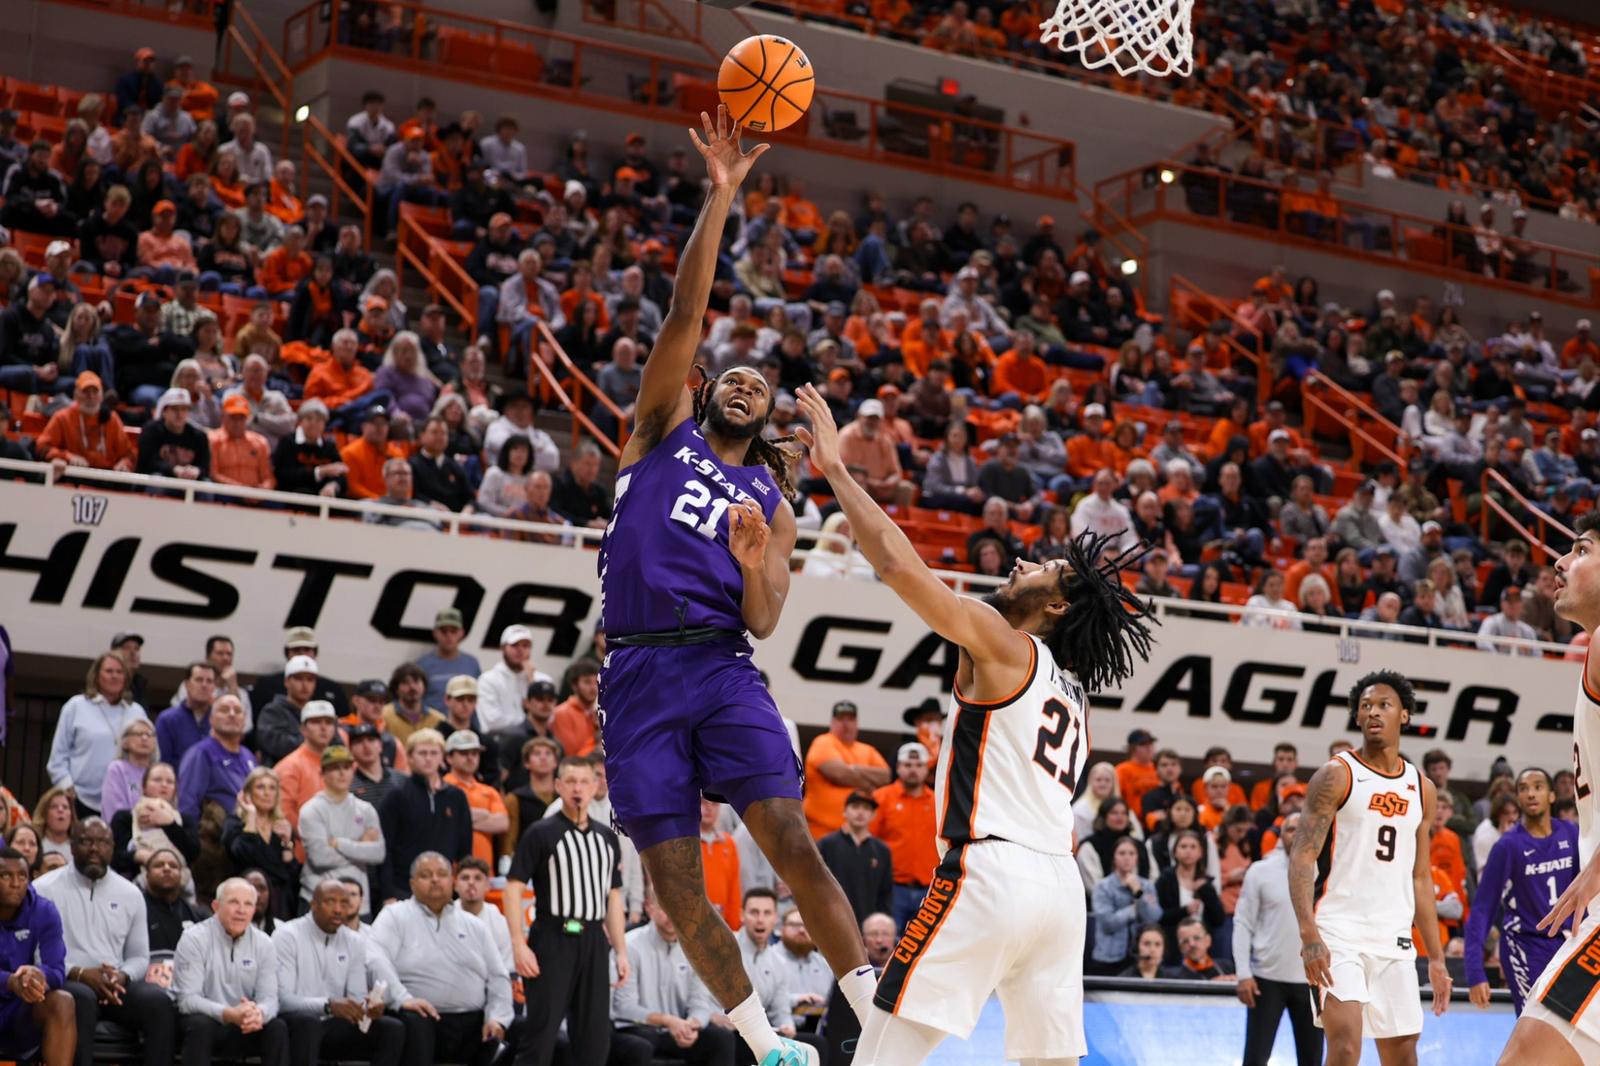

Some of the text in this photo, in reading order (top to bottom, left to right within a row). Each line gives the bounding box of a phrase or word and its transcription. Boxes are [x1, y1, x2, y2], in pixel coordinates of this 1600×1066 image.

[674, 446, 758, 503] K-STAT
[71, 494, 108, 527] 107
[670, 480, 729, 540] 21
[0, 523, 593, 657] HISTOR
[1032, 696, 1081, 795] 21
[1368, 792, 1409, 817] OSU
[1375, 825, 1397, 862] 9
[1525, 856, 1573, 875] K-STATE
[1547, 876, 1559, 906] 1
[895, 878, 954, 964] COWBOYS
